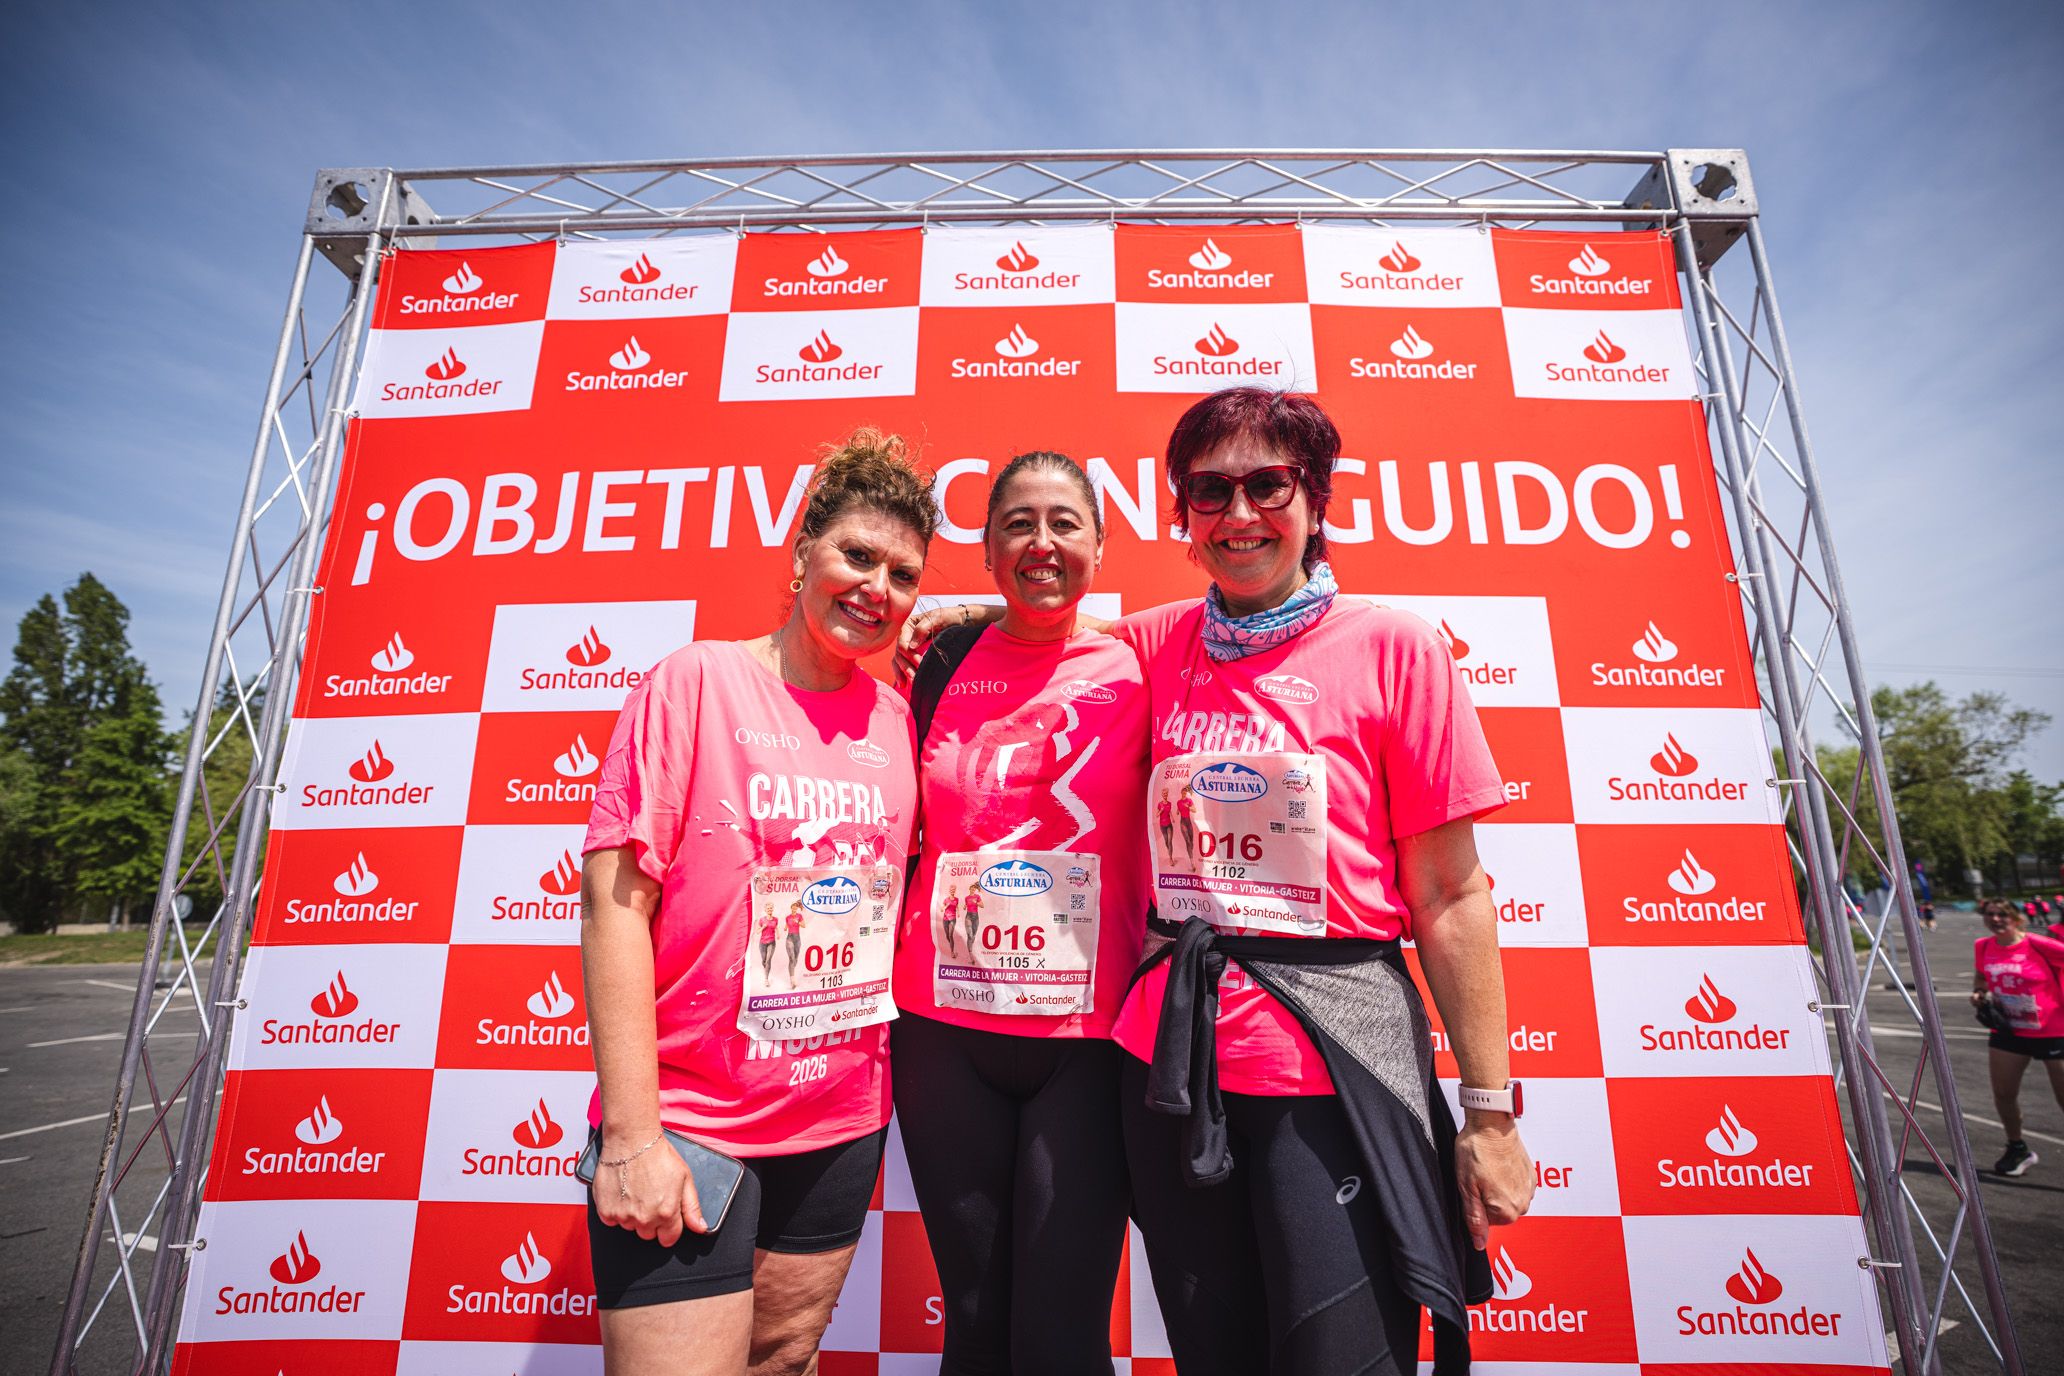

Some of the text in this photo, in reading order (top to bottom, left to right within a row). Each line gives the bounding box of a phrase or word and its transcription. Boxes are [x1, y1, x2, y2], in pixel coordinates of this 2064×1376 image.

[764, 275, 888, 297] Santander
[954, 271, 1081, 290] Santander
[1148, 269, 1274, 288] Santander
[1340, 271, 1464, 291] Santander
[1530, 274, 1652, 295] Santander
[400, 292, 519, 314] Santander
[579, 282, 698, 304] Santander
[756, 361, 883, 383] Santander
[951, 356, 1081, 378] Santander
[1153, 355, 1283, 375] Santander
[1349, 357, 1477, 380] Santander
[1545, 362, 1670, 383] Santander
[381, 377, 502, 402] Santander
[565, 368, 688, 391] Santander
[351, 457, 1691, 586] ¡OBJETIV CNGUIDO!
[324, 672, 452, 698] Santander
[519, 667, 647, 691] Santande
[1590, 662, 1726, 687] Santander
[948, 681, 1008, 696] OYSHO
[1065, 686, 1113, 701] ASTURIANA
[1260, 681, 1313, 701] ASTURIANA
[735, 727, 800, 751] OYSHO
[1164, 769, 1189, 780] SUMA
[1197, 776, 1262, 794] ASTURIANA
[301, 783, 434, 808] Santander
[506, 779, 596, 802] Santan
[747, 772, 888, 827] CARRERA
[1608, 777, 1748, 801] Santander
[1198, 831, 1263, 862] 016
[951, 867, 978, 877] SUMA
[984, 873, 1047, 888] ASTURIANA
[1212, 865, 1246, 879] 1102
[766, 882, 799, 893] SUMA
[807, 890, 858, 906] ASTURIANA
[1160, 877, 1192, 887] CARRERA
[1202, 880, 1233, 892] MUJER
[1239, 883, 1317, 901] VITORIA-GASTEIZ
[284, 898, 419, 924] Santander
[491, 897, 582, 921] Santan
[1243, 905, 1302, 923] Santander
[1623, 897, 1767, 922] Santander
[982, 924, 1046, 951] 016
[804, 941, 854, 972] 016
[998, 956, 1030, 969] 1105
[820, 975, 844, 989] 1103
[940, 968, 1088, 982] CARRERA DE LA MUJER VITORIA-GASTEIZ
[751, 982, 887, 1009] CARRERA DE LA MUJER VITORIA-GASTEIZ
[952, 987, 995, 1003] OYSHO
[1029, 994, 1077, 1005] Santander
[762, 1015, 815, 1031] OYSHO
[842, 1005, 879, 1020] Santander
[261, 1018, 400, 1045] Santander
[476, 1019, 590, 1046] Santand
[1640, 1024, 1790, 1051] Santander
[788, 1054, 828, 1087] 2026
[242, 1147, 386, 1175] Santander
[462, 1148, 580, 1177] Santand
[1657, 1159, 1813, 1188] Santander
[215, 1285, 366, 1315] Santander
[446, 1284, 597, 1316] Santander
[1426, 1303, 1589, 1333] ntander
[1676, 1305, 1842, 1337] Santander
